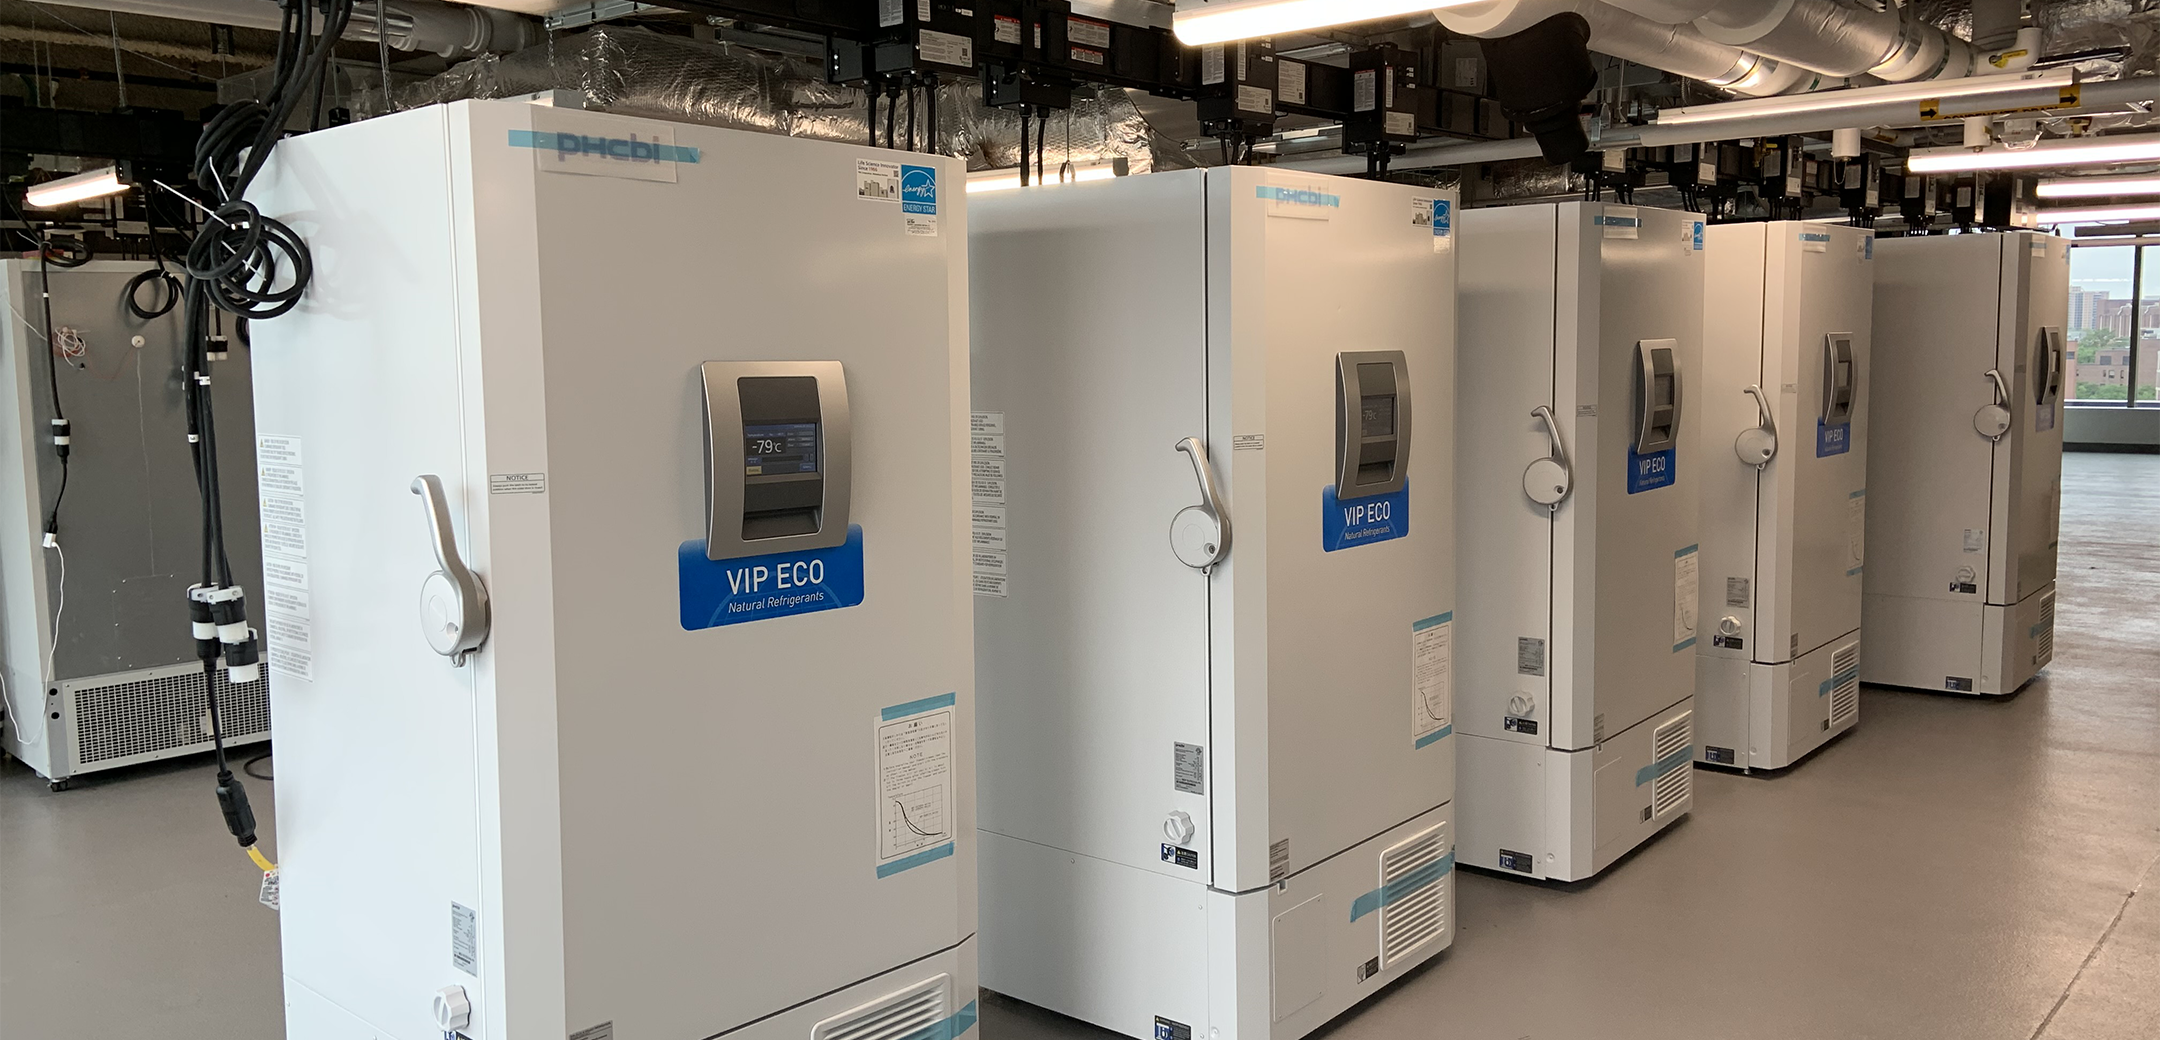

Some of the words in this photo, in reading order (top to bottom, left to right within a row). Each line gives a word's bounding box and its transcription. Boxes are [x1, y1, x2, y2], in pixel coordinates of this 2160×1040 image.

[903, 204, 922, 212] ENERGY
[923, 205, 935, 213] STAR
[1639, 459, 1651, 475] VIP
[1652, 456, 1665, 473] ECO
[1344, 505, 1364, 526] VIP
[1368, 501, 1390, 523] ECO
[1345, 529, 1363, 540] Natural
[1363, 526, 1390, 537] Refrigerants
[726, 566, 769, 595] VIP
[777, 559, 824, 589] ECO
[728, 598, 765, 613] Natural
[767, 591, 824, 608] Refrigerants
